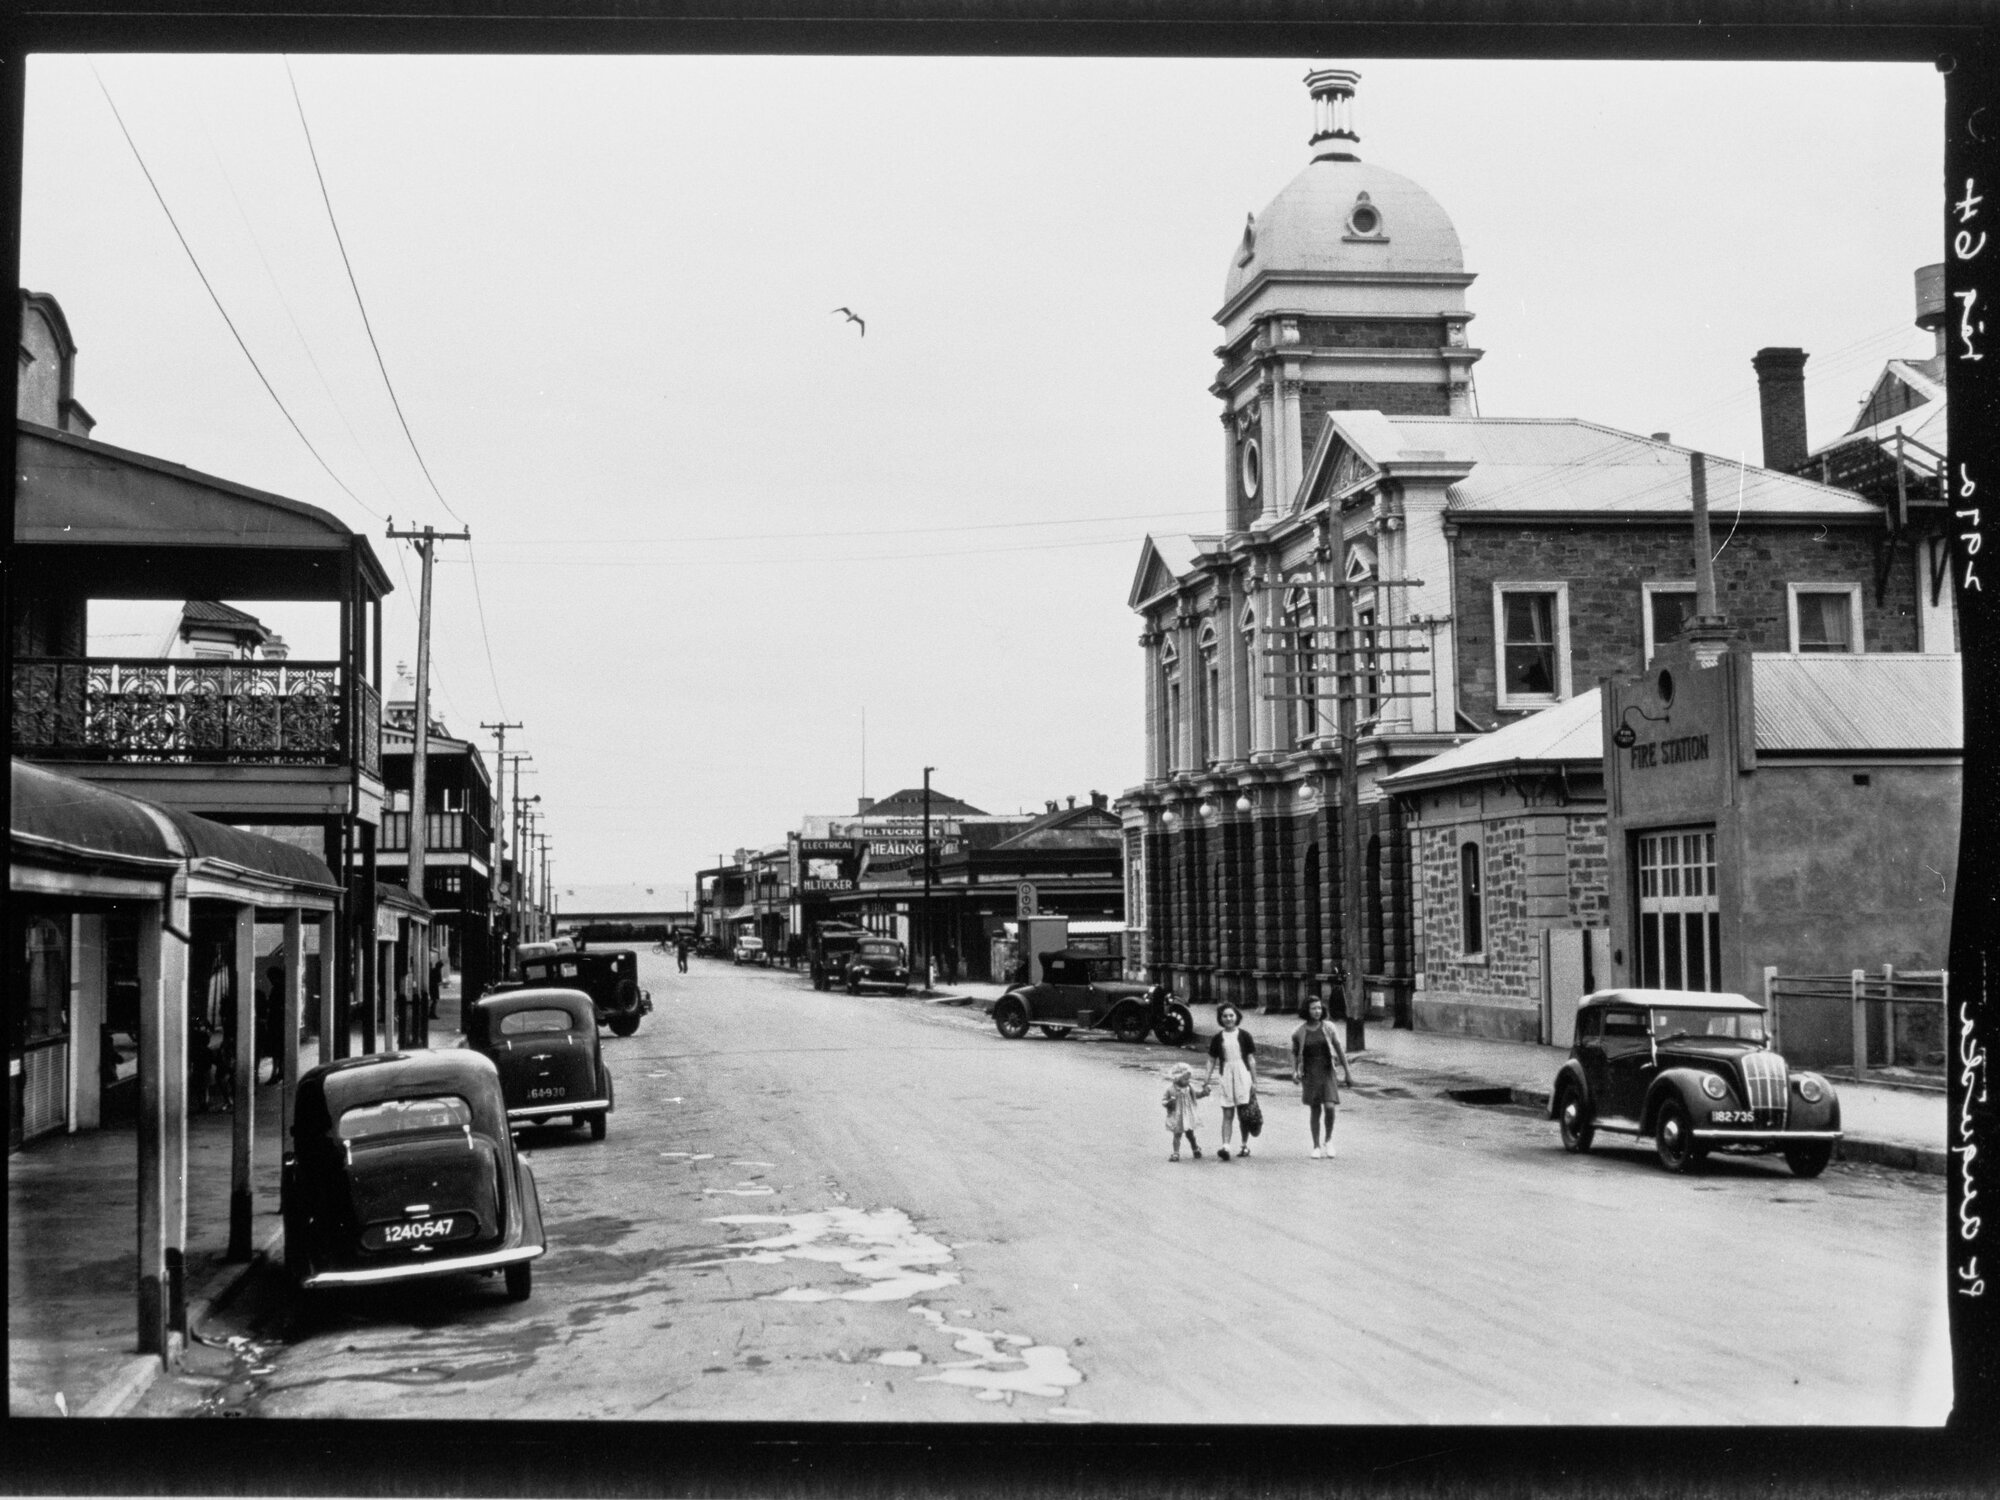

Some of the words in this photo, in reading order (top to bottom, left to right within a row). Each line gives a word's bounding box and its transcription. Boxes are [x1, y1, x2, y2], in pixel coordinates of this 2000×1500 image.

[1631, 742, 1657, 769] FIRE
[1661, 734, 1708, 764] STATION
[802, 841, 853, 850] ELECTRICAL
[870, 843, 924, 855] HEALING
